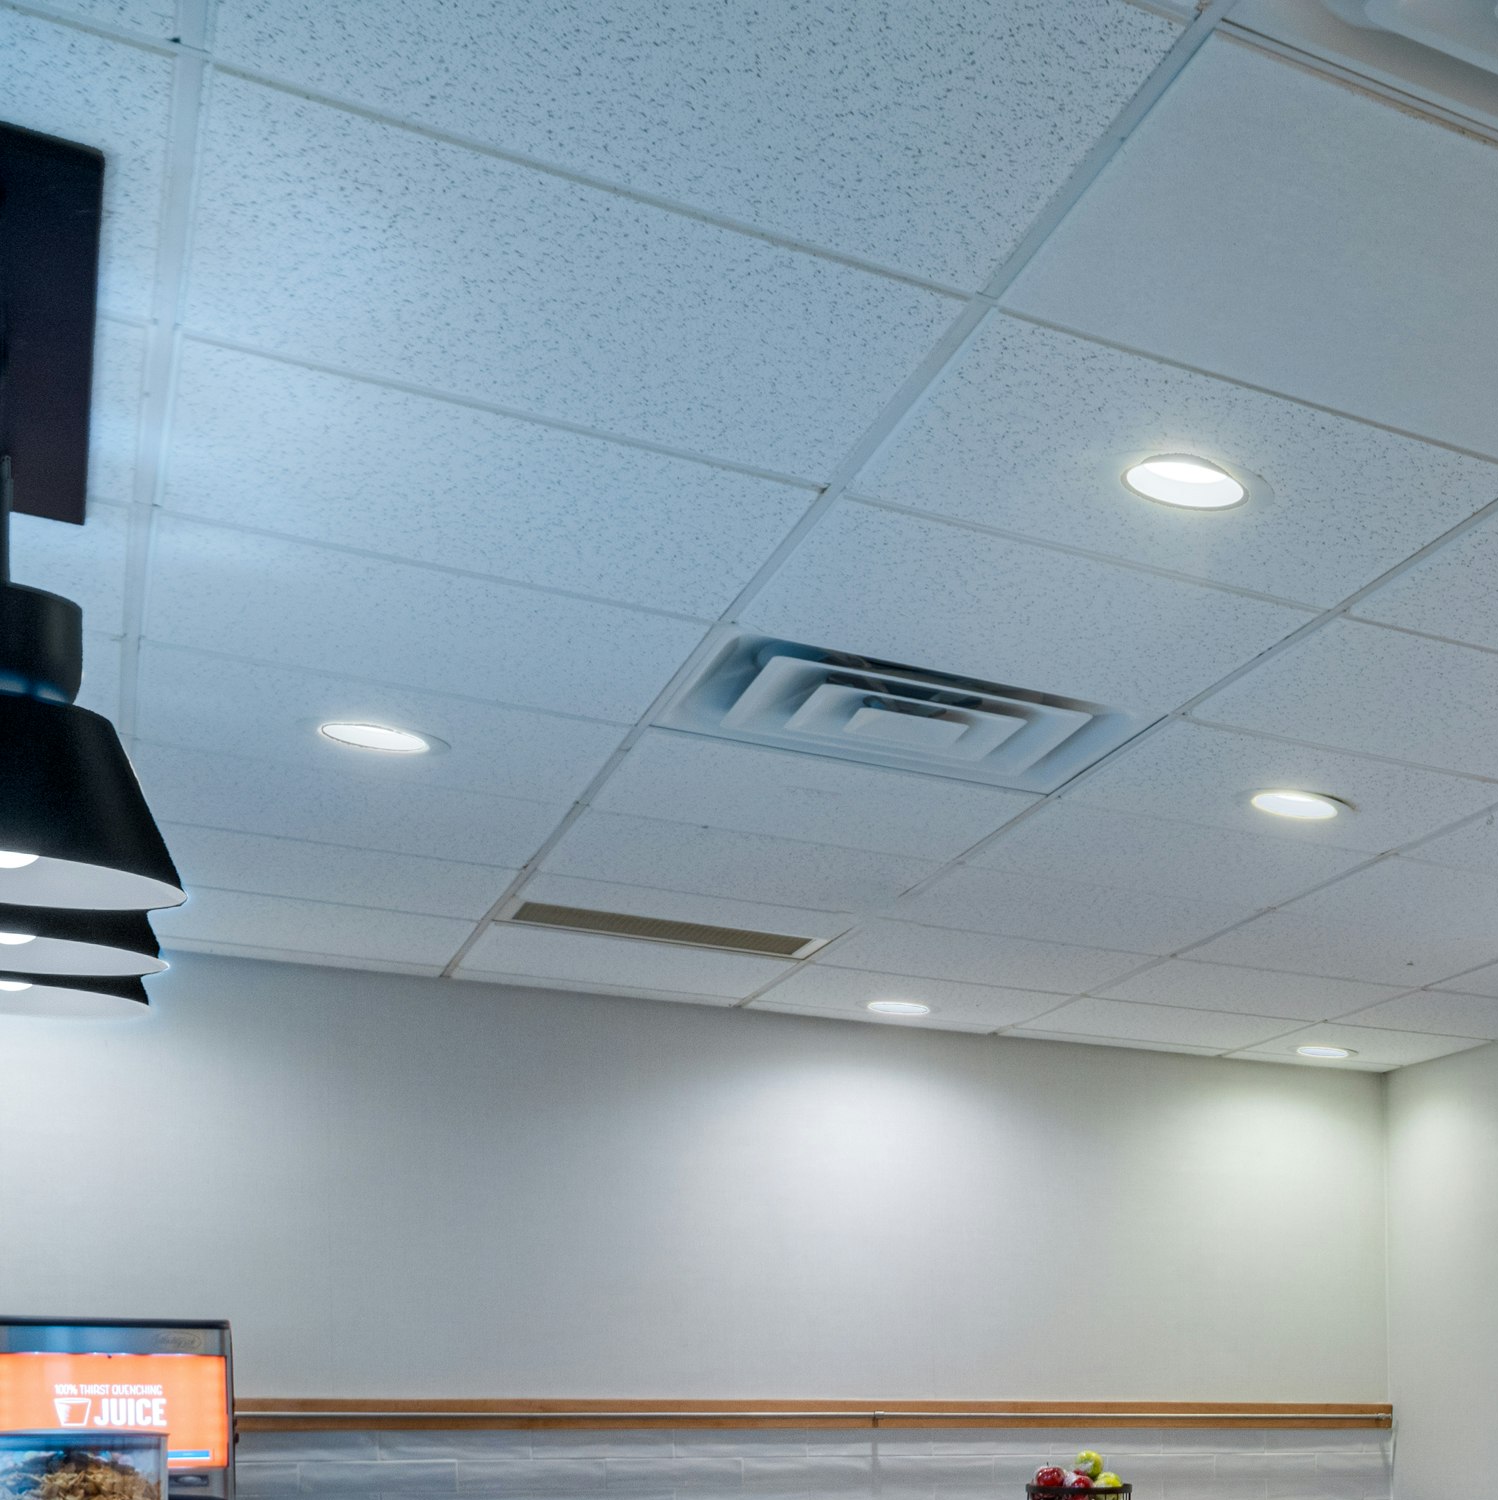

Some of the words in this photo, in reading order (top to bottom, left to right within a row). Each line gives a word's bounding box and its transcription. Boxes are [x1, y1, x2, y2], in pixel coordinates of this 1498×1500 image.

[55, 1384, 78, 1396] 100%
[80, 1384, 109, 1396] THIRST
[112, 1384, 162, 1396] QUENCHING
[94, 1398, 167, 1426] JUICE
